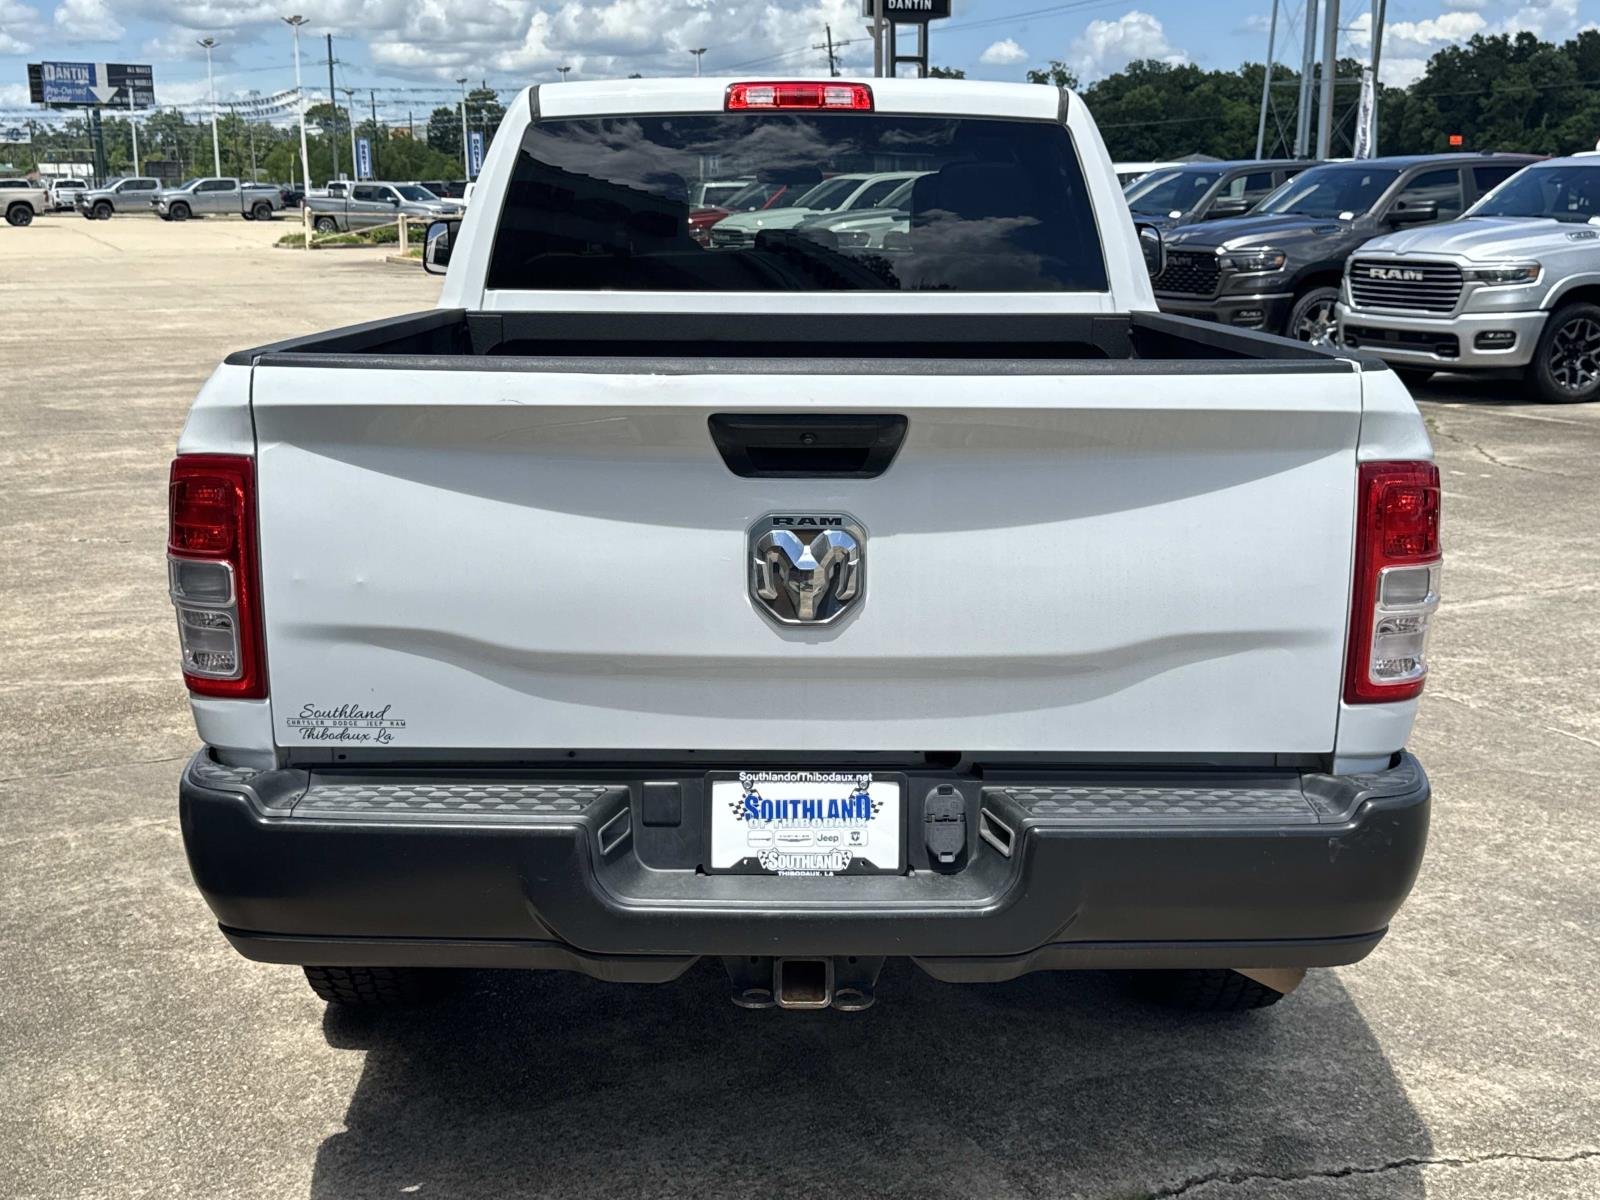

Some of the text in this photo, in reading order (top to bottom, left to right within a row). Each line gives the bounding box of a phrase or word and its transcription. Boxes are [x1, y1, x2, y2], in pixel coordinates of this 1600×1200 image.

[887, 0, 932, 10] DANTIN
[43, 63, 90, 80] DANTIN
[46, 86, 87, 97] Pre-Owned
[1369, 268, 1424, 280] RAM
[772, 517, 842, 526] RAM
[299, 703, 392, 721] Southland
[299, 727, 396, 744] Thibodaux La
[739, 772, 873, 782] SouthlandofThibodaux.net
[744, 794, 872, 824] SOUTHLAND
[772, 818, 868, 829] THIBODAUX
[816, 833, 840, 844] Jeep
[767, 851, 843, 870] SOUTHLAND
